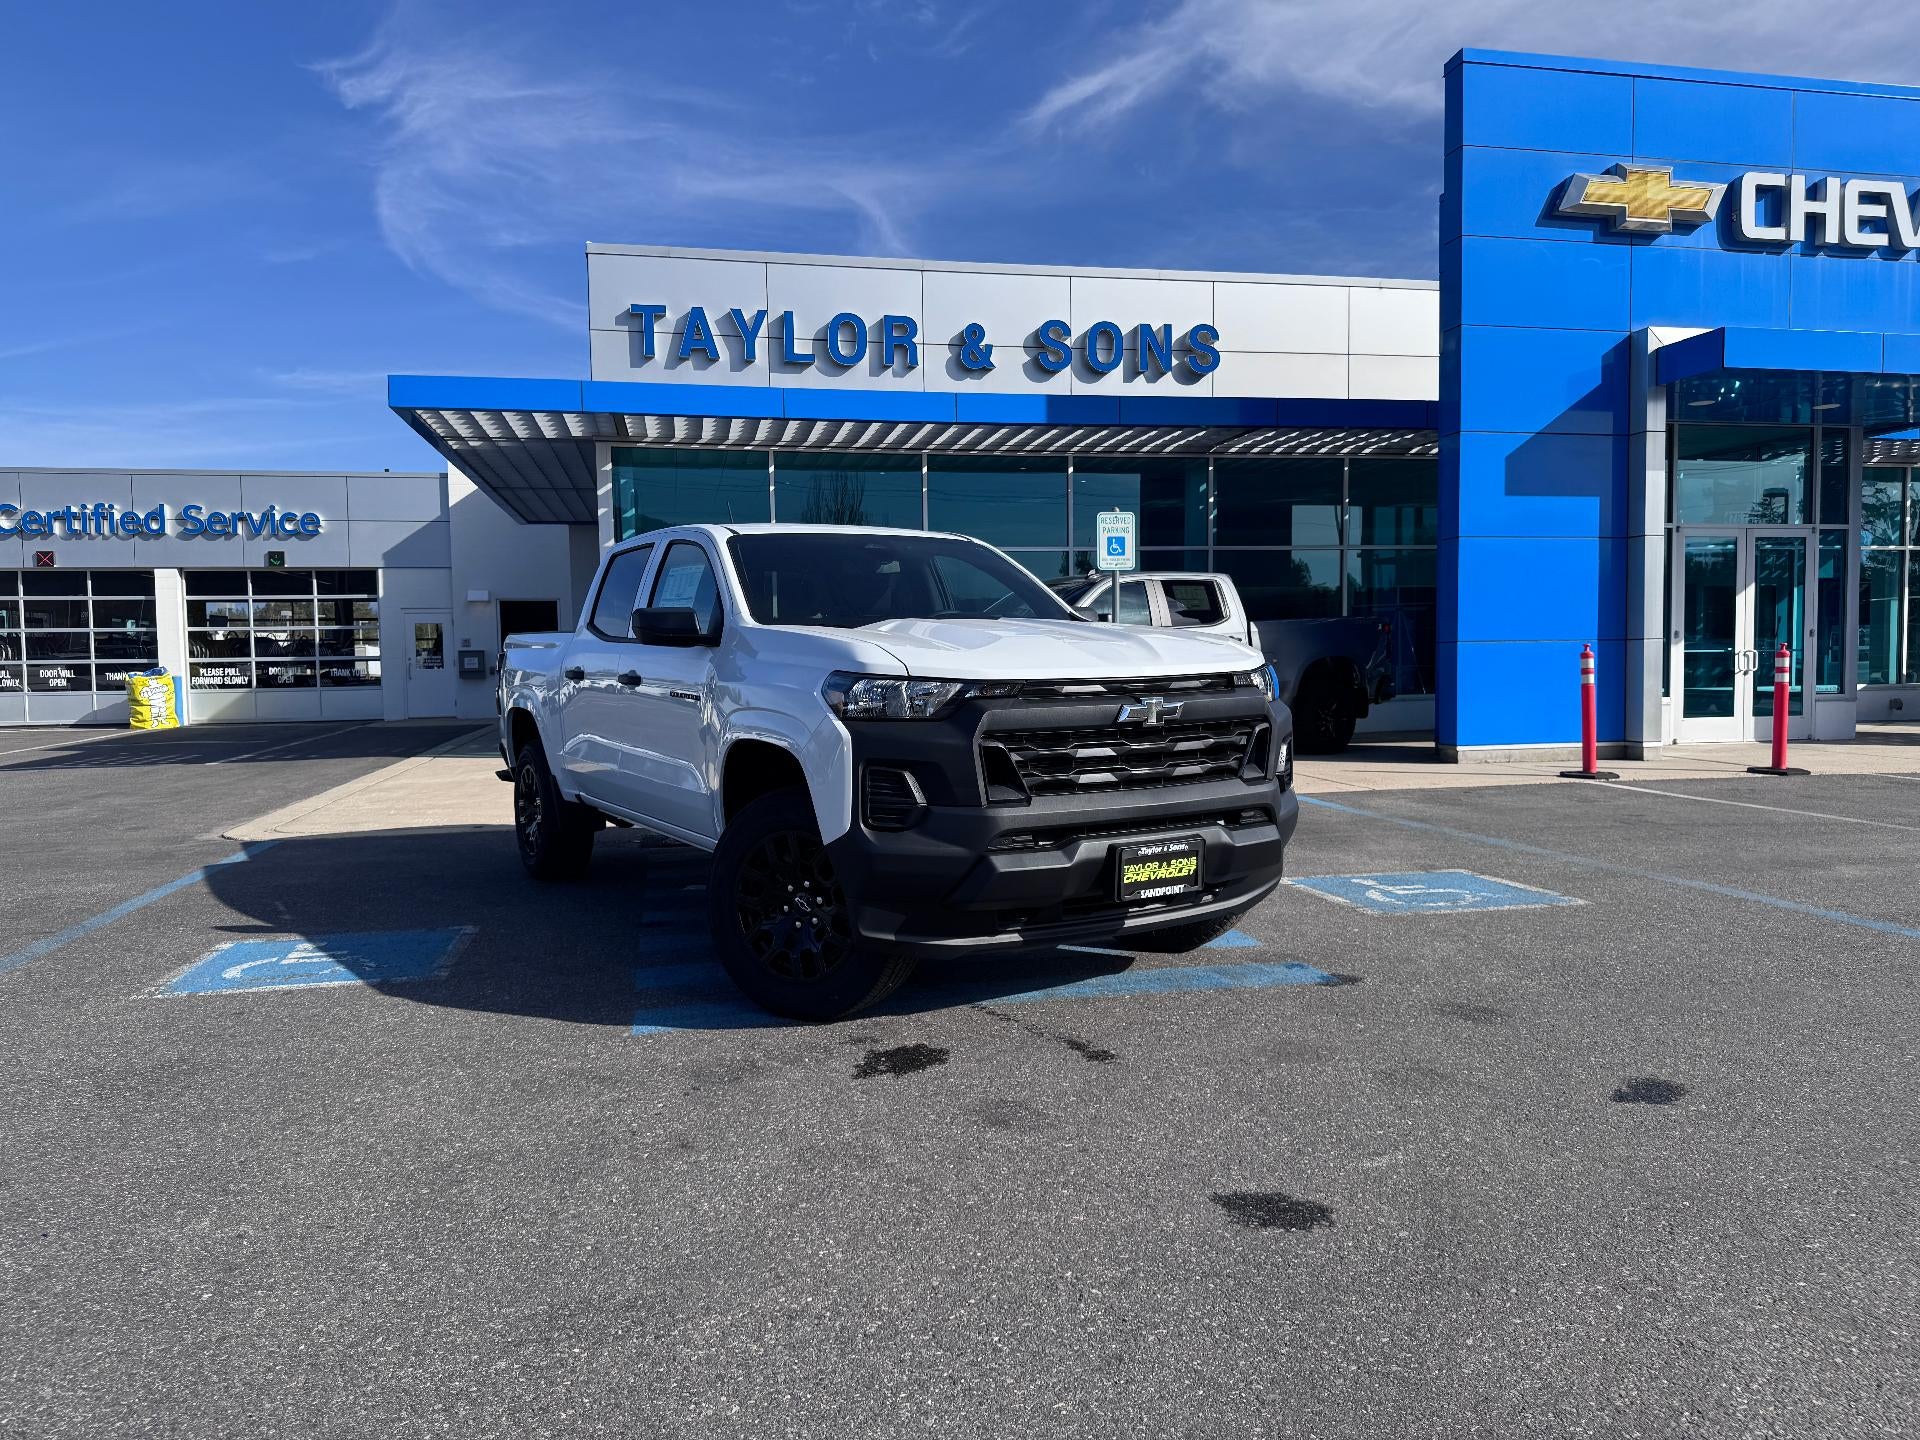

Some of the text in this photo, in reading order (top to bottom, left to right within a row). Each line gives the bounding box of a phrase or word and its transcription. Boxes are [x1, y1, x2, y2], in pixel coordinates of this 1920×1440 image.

[630, 303, 1221, 374] TAYLOR & SONS
[0, 502, 322, 535] Certified Service
[1100, 516, 1131, 525] RESERVED
[1102, 526, 1130, 534] PARKING
[40, 669, 76, 678] DOOR WILL
[200, 667, 241, 676] PLEASE PULL
[268, 667, 286, 675] DOOR
[330, 668, 351, 677] THANK
[105, 672, 128, 681] THANK
[191, 675, 249, 685] FORWARD SLOWLY
[49, 678, 67, 687] OPEN
[1141, 845, 1163, 855] Taylor
[1168, 843, 1186, 852] Sons
[1123, 861, 1159, 873] TAYLOR
[1170, 857, 1197, 867] SONS
[1123, 867, 1197, 884] CHEVROLET
[1140, 884, 1185, 899] SANDPOINT
